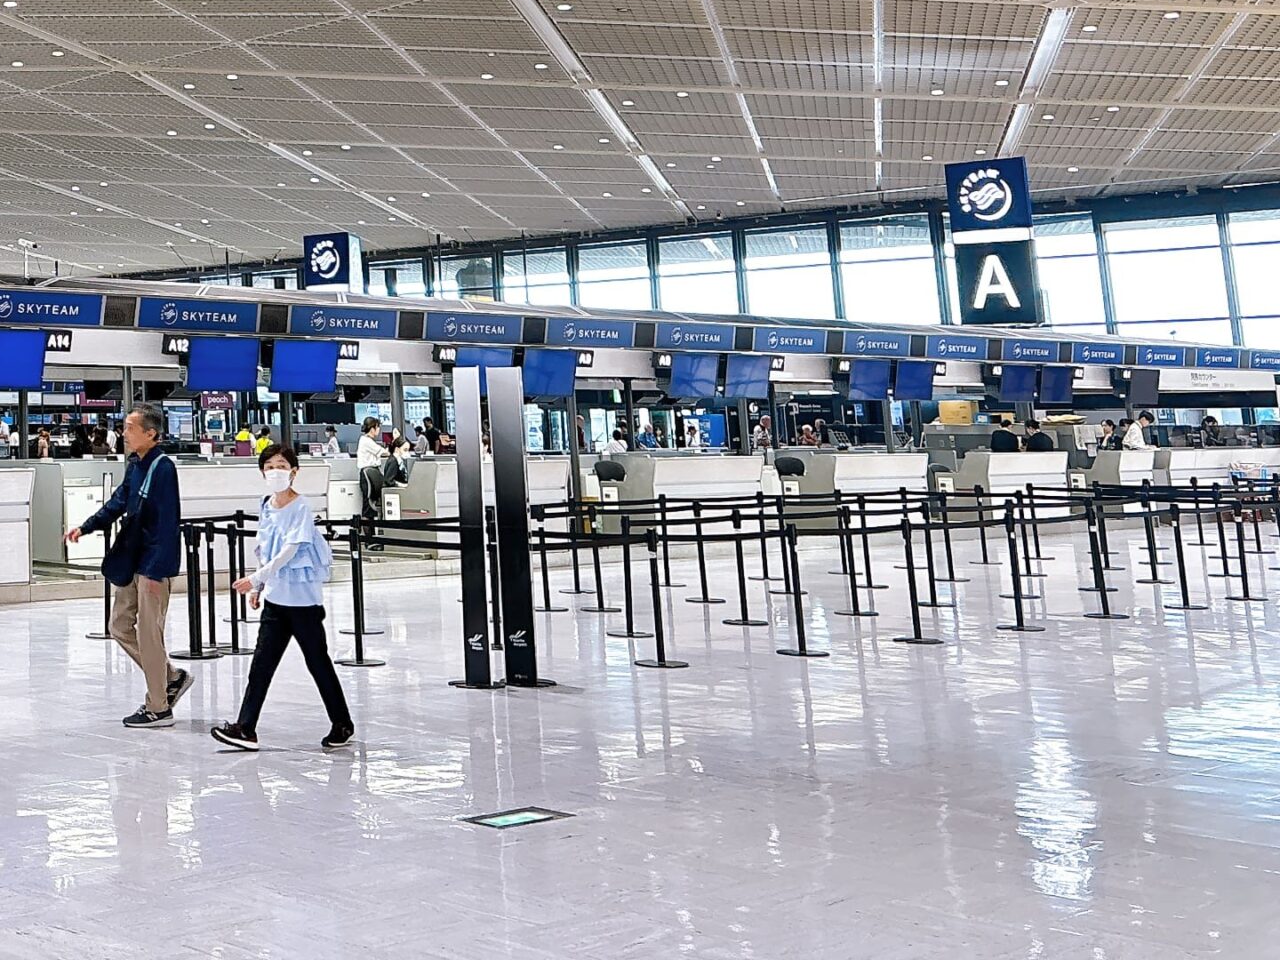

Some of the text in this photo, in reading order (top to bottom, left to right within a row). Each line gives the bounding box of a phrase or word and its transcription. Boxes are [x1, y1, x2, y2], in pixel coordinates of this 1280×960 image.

[973, 254, 1021, 309] A
[18, 302, 80, 316] SKYTEAM
[181, 311, 237, 323] SKYTEAM
[329, 318, 379, 329] SKYTEAM
[460, 323, 505, 335] SKYTEAM
[578, 329, 619, 339] SKYTEAM
[684, 333, 721, 342] SKYTEAM
[47, 334, 70, 348] A14
[168, 338, 189, 352] A12
[780, 337, 813, 346] SKYTEAM
[867, 341, 898, 350] SKYTEAM
[339, 344, 358, 357] A11
[439, 348, 456, 361] A10
[947, 344, 977, 353] SKYTEAM
[1022, 348, 1049, 356] SKYTEAM
[772, 358, 784, 369] A7
[207, 394, 228, 406] peach
